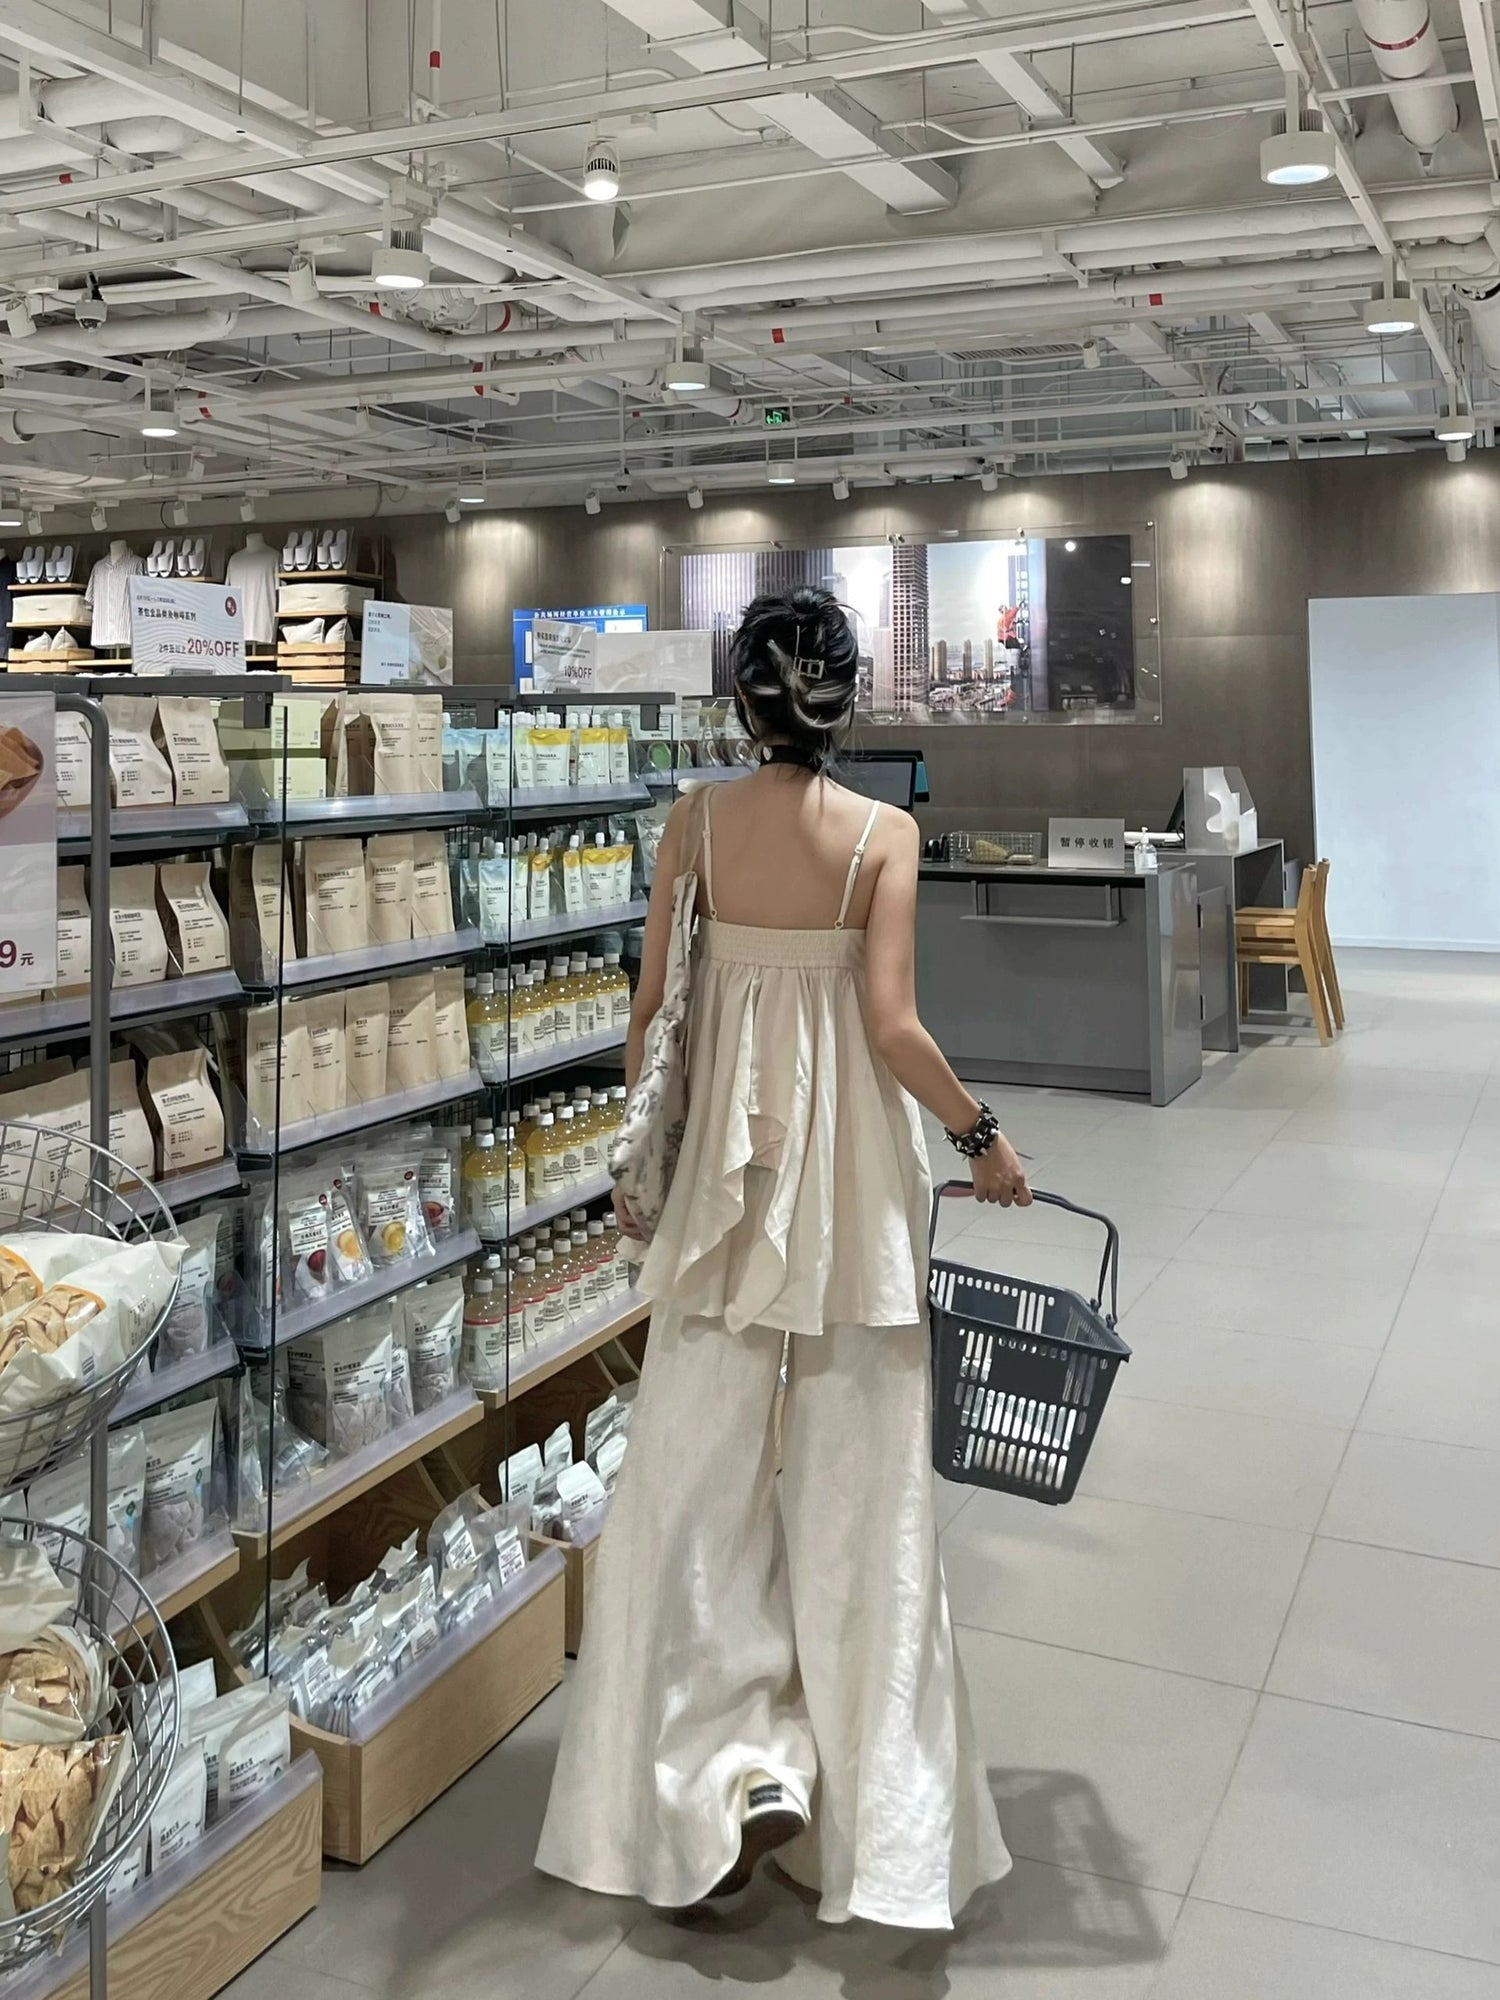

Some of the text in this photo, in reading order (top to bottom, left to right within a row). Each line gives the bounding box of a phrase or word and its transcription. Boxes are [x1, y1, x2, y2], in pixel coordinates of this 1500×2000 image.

[187, 638, 240, 658] 20%OFF
[563, 665, 593, 681] 10%OFF
[1060, 837, 1114, 849] 暂停收银
